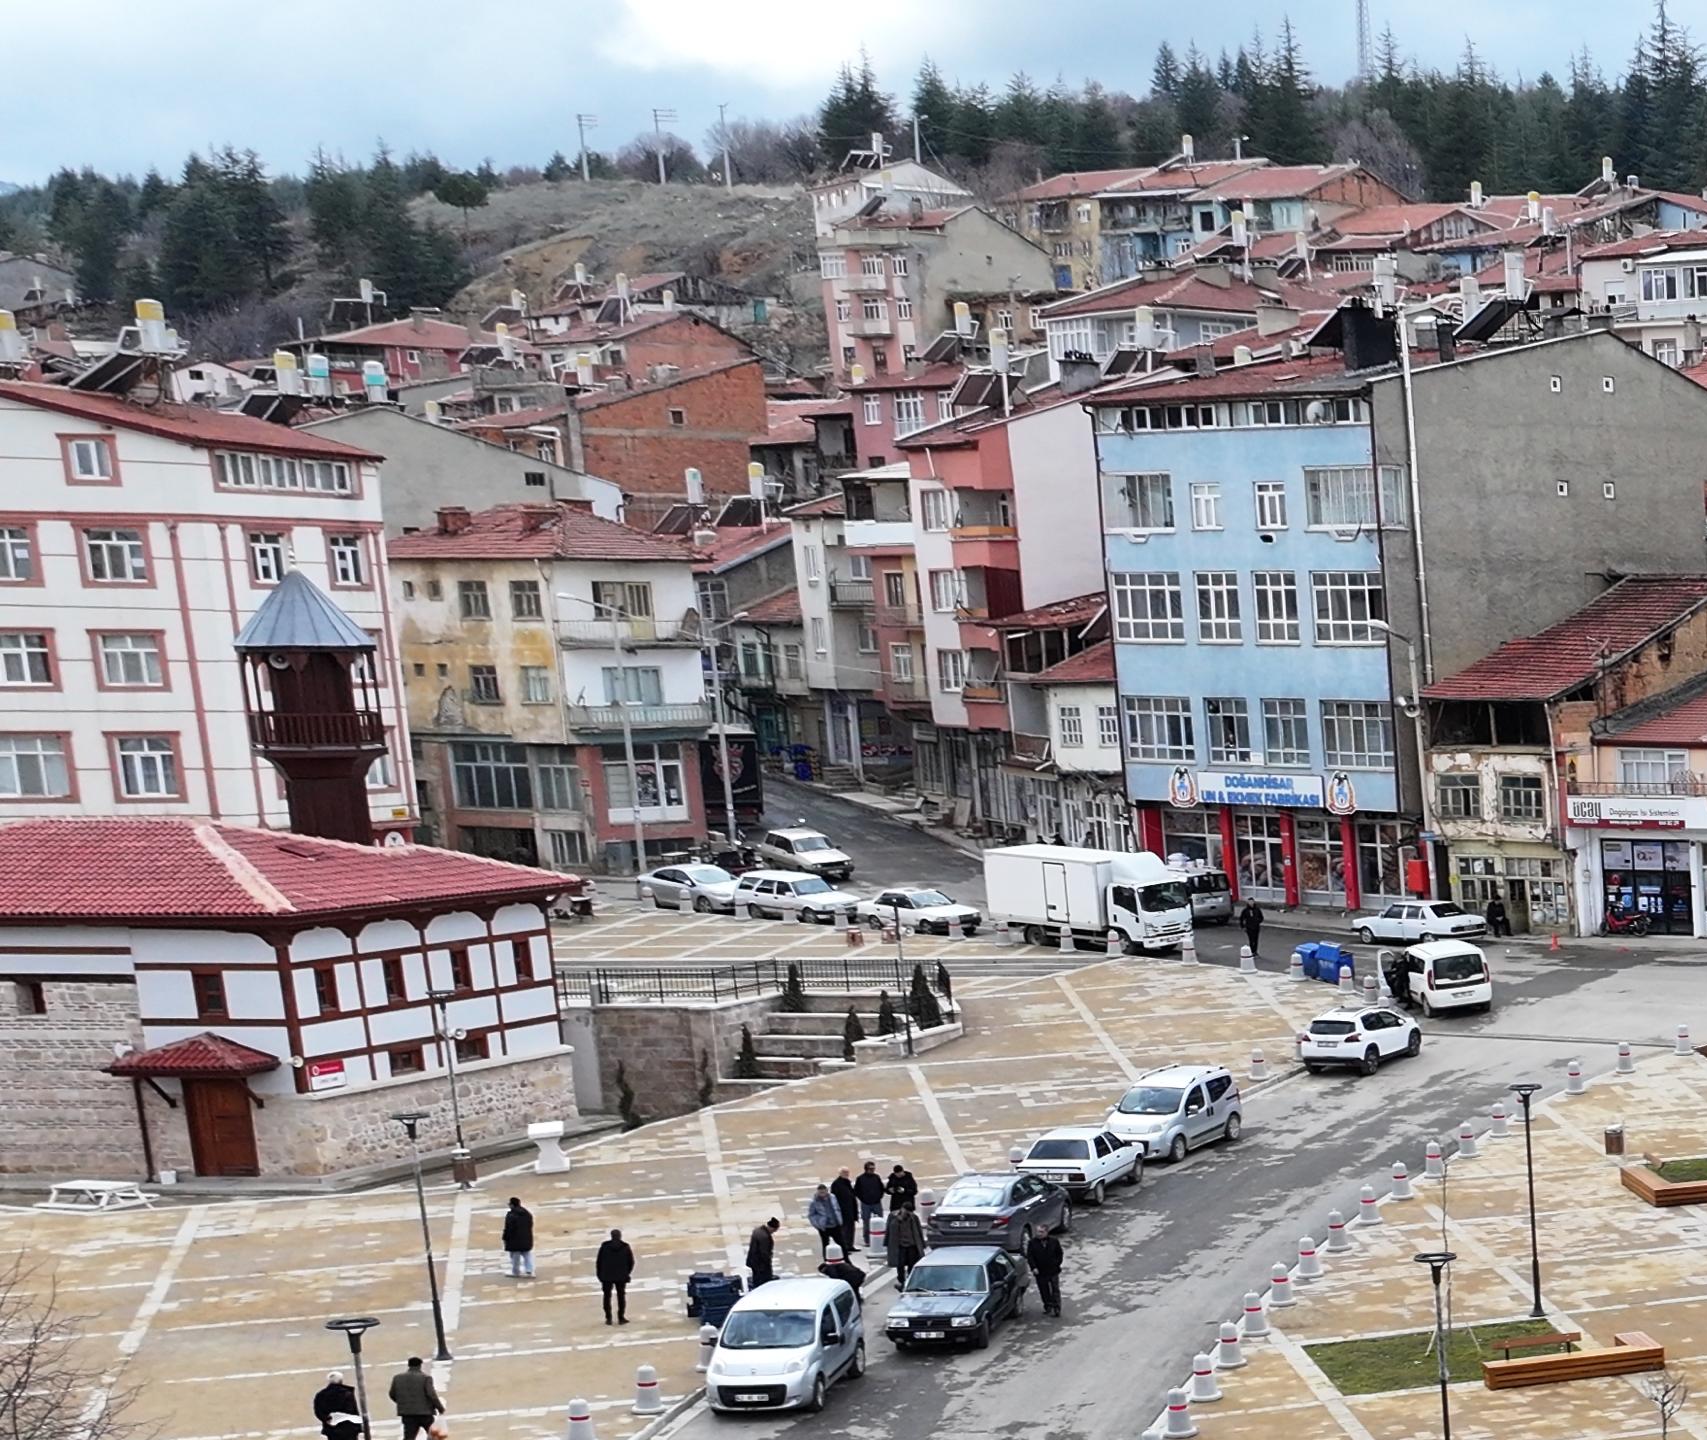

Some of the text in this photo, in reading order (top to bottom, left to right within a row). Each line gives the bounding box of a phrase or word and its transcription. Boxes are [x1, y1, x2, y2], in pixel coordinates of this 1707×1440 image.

[1225, 774, 1293, 789] DOĞANHİSAR
[1201, 790, 1216, 801] UN
[1218, 791, 1224, 802] &
[1264, 792, 1319, 805] FABRİKASI
